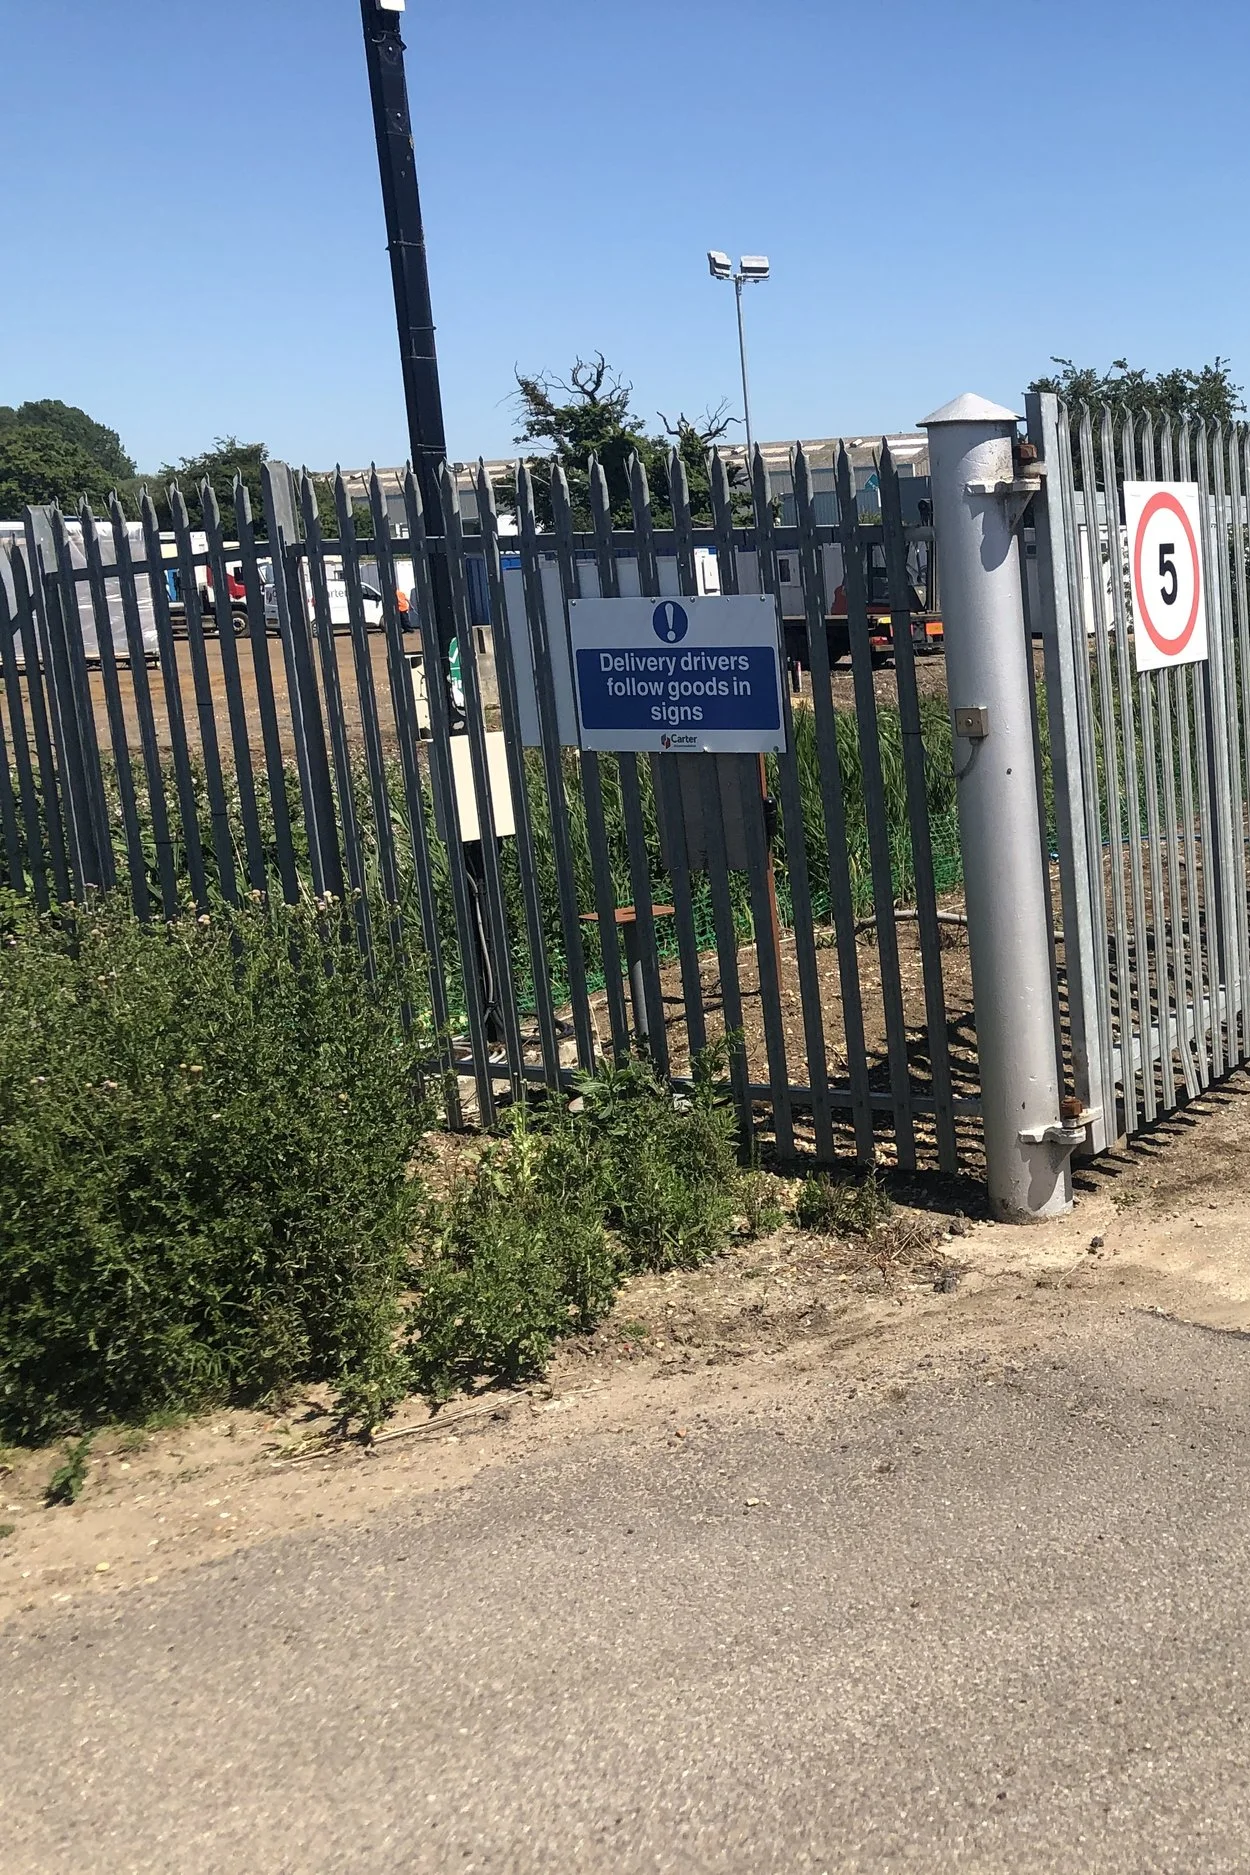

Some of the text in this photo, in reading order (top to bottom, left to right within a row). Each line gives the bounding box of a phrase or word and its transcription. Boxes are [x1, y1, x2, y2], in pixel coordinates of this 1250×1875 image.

[1159, 543, 1178, 605] 5
[600, 652, 750, 675] Delivery drivers
[606, 677, 751, 700] follow goods in
[650, 702, 704, 725] signs
[671, 733, 698, 743] Carter
